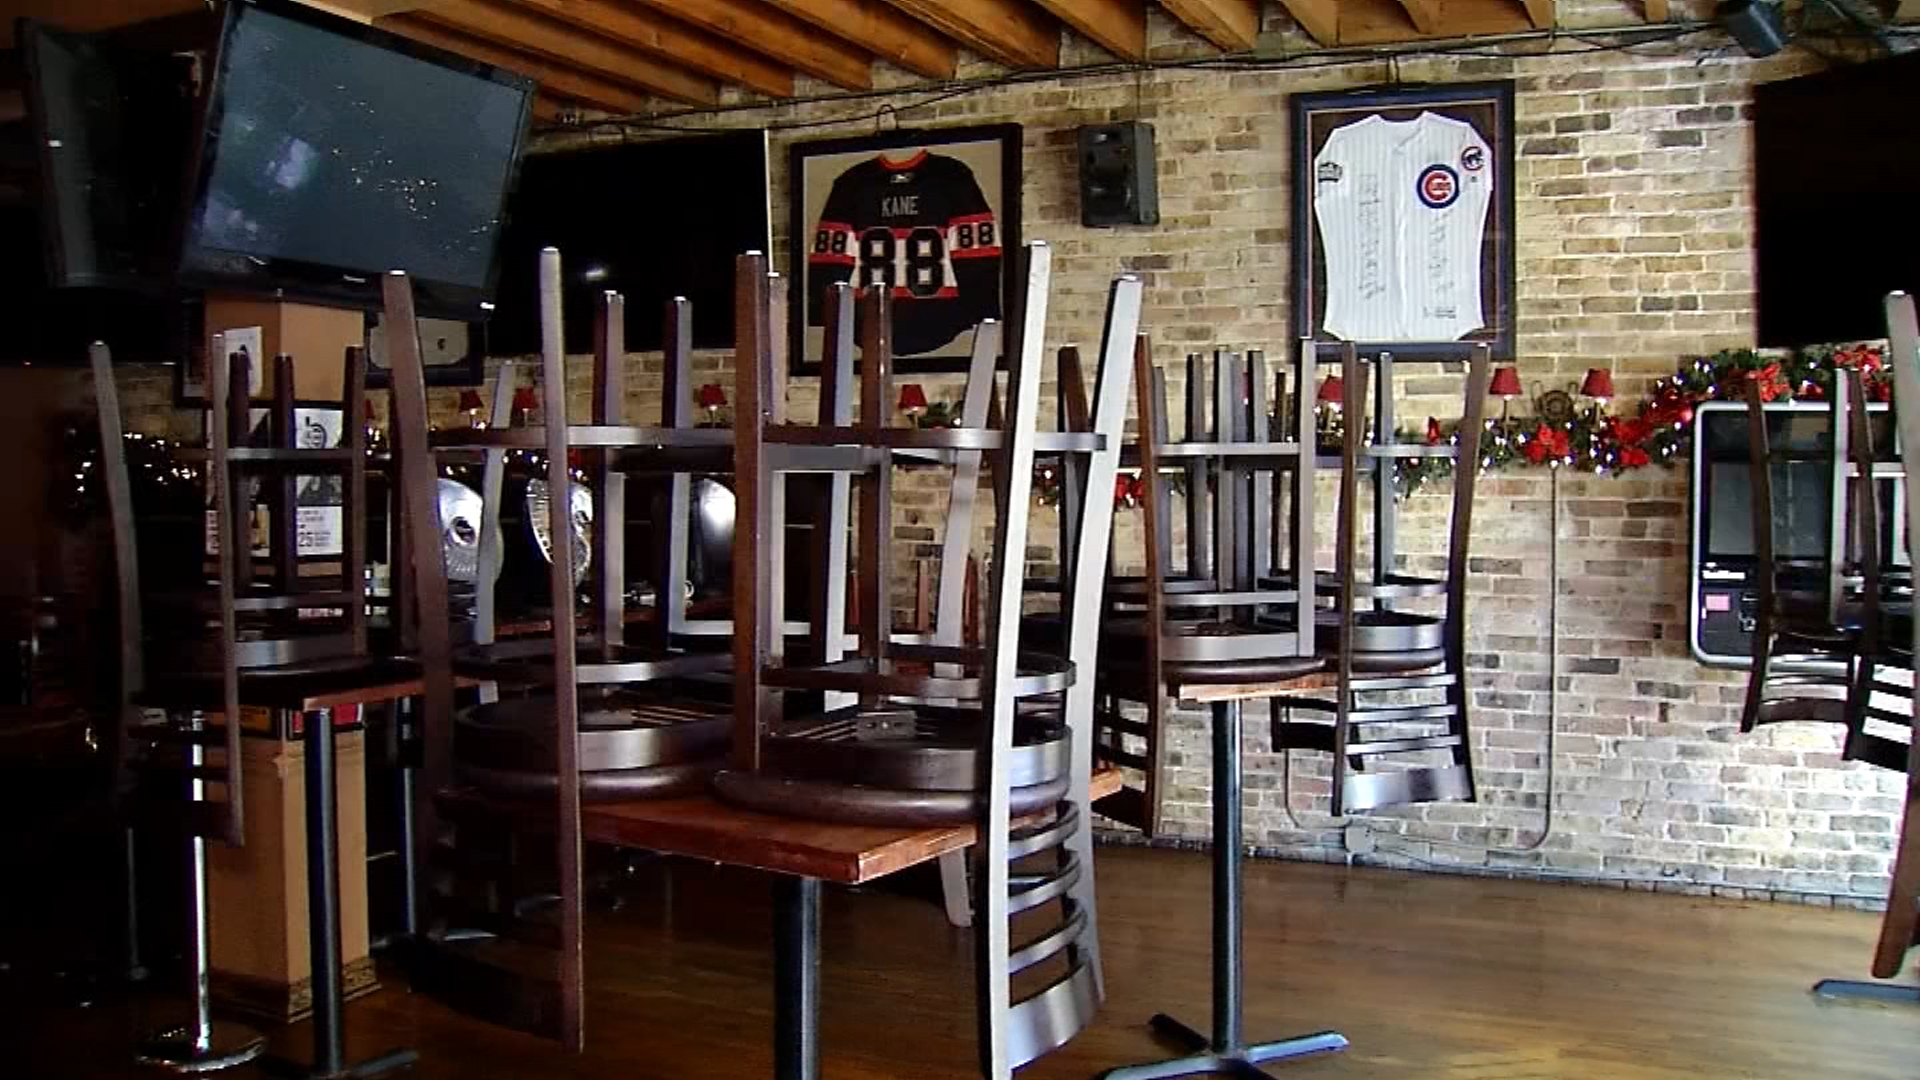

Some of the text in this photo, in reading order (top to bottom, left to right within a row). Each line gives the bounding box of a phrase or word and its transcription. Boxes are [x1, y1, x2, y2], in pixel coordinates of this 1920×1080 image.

[881, 195, 919, 217] KANE
[814, 230, 849, 254] 88
[957, 221, 995, 249] 88
[859, 226, 944, 299] 88
